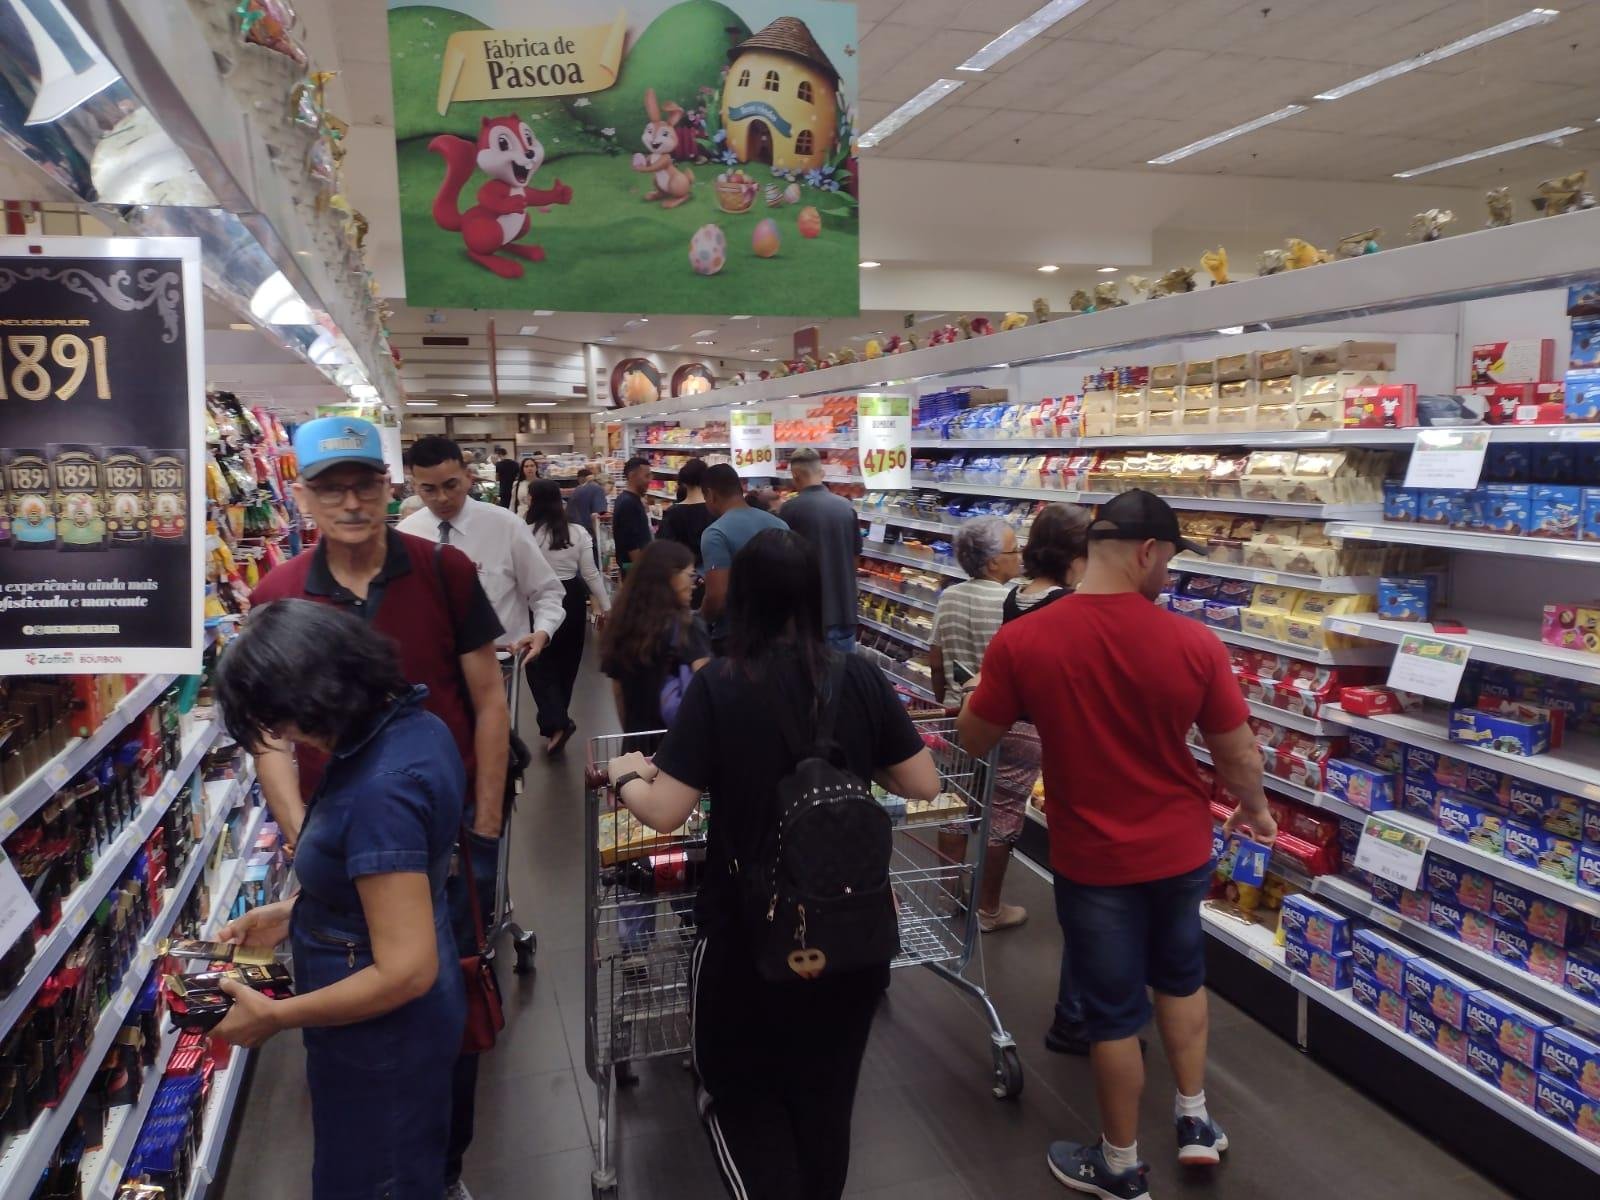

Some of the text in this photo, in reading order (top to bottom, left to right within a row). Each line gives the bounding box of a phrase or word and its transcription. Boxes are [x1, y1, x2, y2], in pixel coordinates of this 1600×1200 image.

[484, 36, 575, 59] Fábrica de
[487, 61, 584, 90] Páscoa
[11, 468, 49, 489] 1891
[53, 465, 98, 488] 1891
[106, 467, 142, 488] 1891
[151, 468, 182, 488] 1891
[5, 579, 86, 595] experiência
[87, 578, 125, 591] ainda
[128, 579, 158, 591] mais
[0, 595, 149, 612] fisticada e marcante
[1327, 767, 1348, 784] LACTA
[1405, 783, 1432, 800] LACTA
[1510, 788, 1543, 807] LACTA
[1440, 806, 1470, 825] LACTA
[1506, 828, 1539, 849] LACTA
[1428, 863, 1458, 882] LACTA
[1431, 901, 1460, 920] LACTA
[1493, 889, 1526, 911] LACTA
[1283, 905, 1306, 924] LACTA
[1495, 928, 1528, 950] LACTA
[1287, 940, 1309, 960] LACTA
[1353, 940, 1376, 961] LACTA
[1353, 977, 1377, 998] LACTA
[1405, 970, 1431, 993] LACTA
[1409, 1008, 1436, 1032] LACTA
[1467, 1004, 1498, 1029] LACTA
[1468, 1043, 1499, 1070] LACTA
[1542, 1042, 1578, 1068] LACTA
[1538, 1084, 1575, 1112] LACTA
